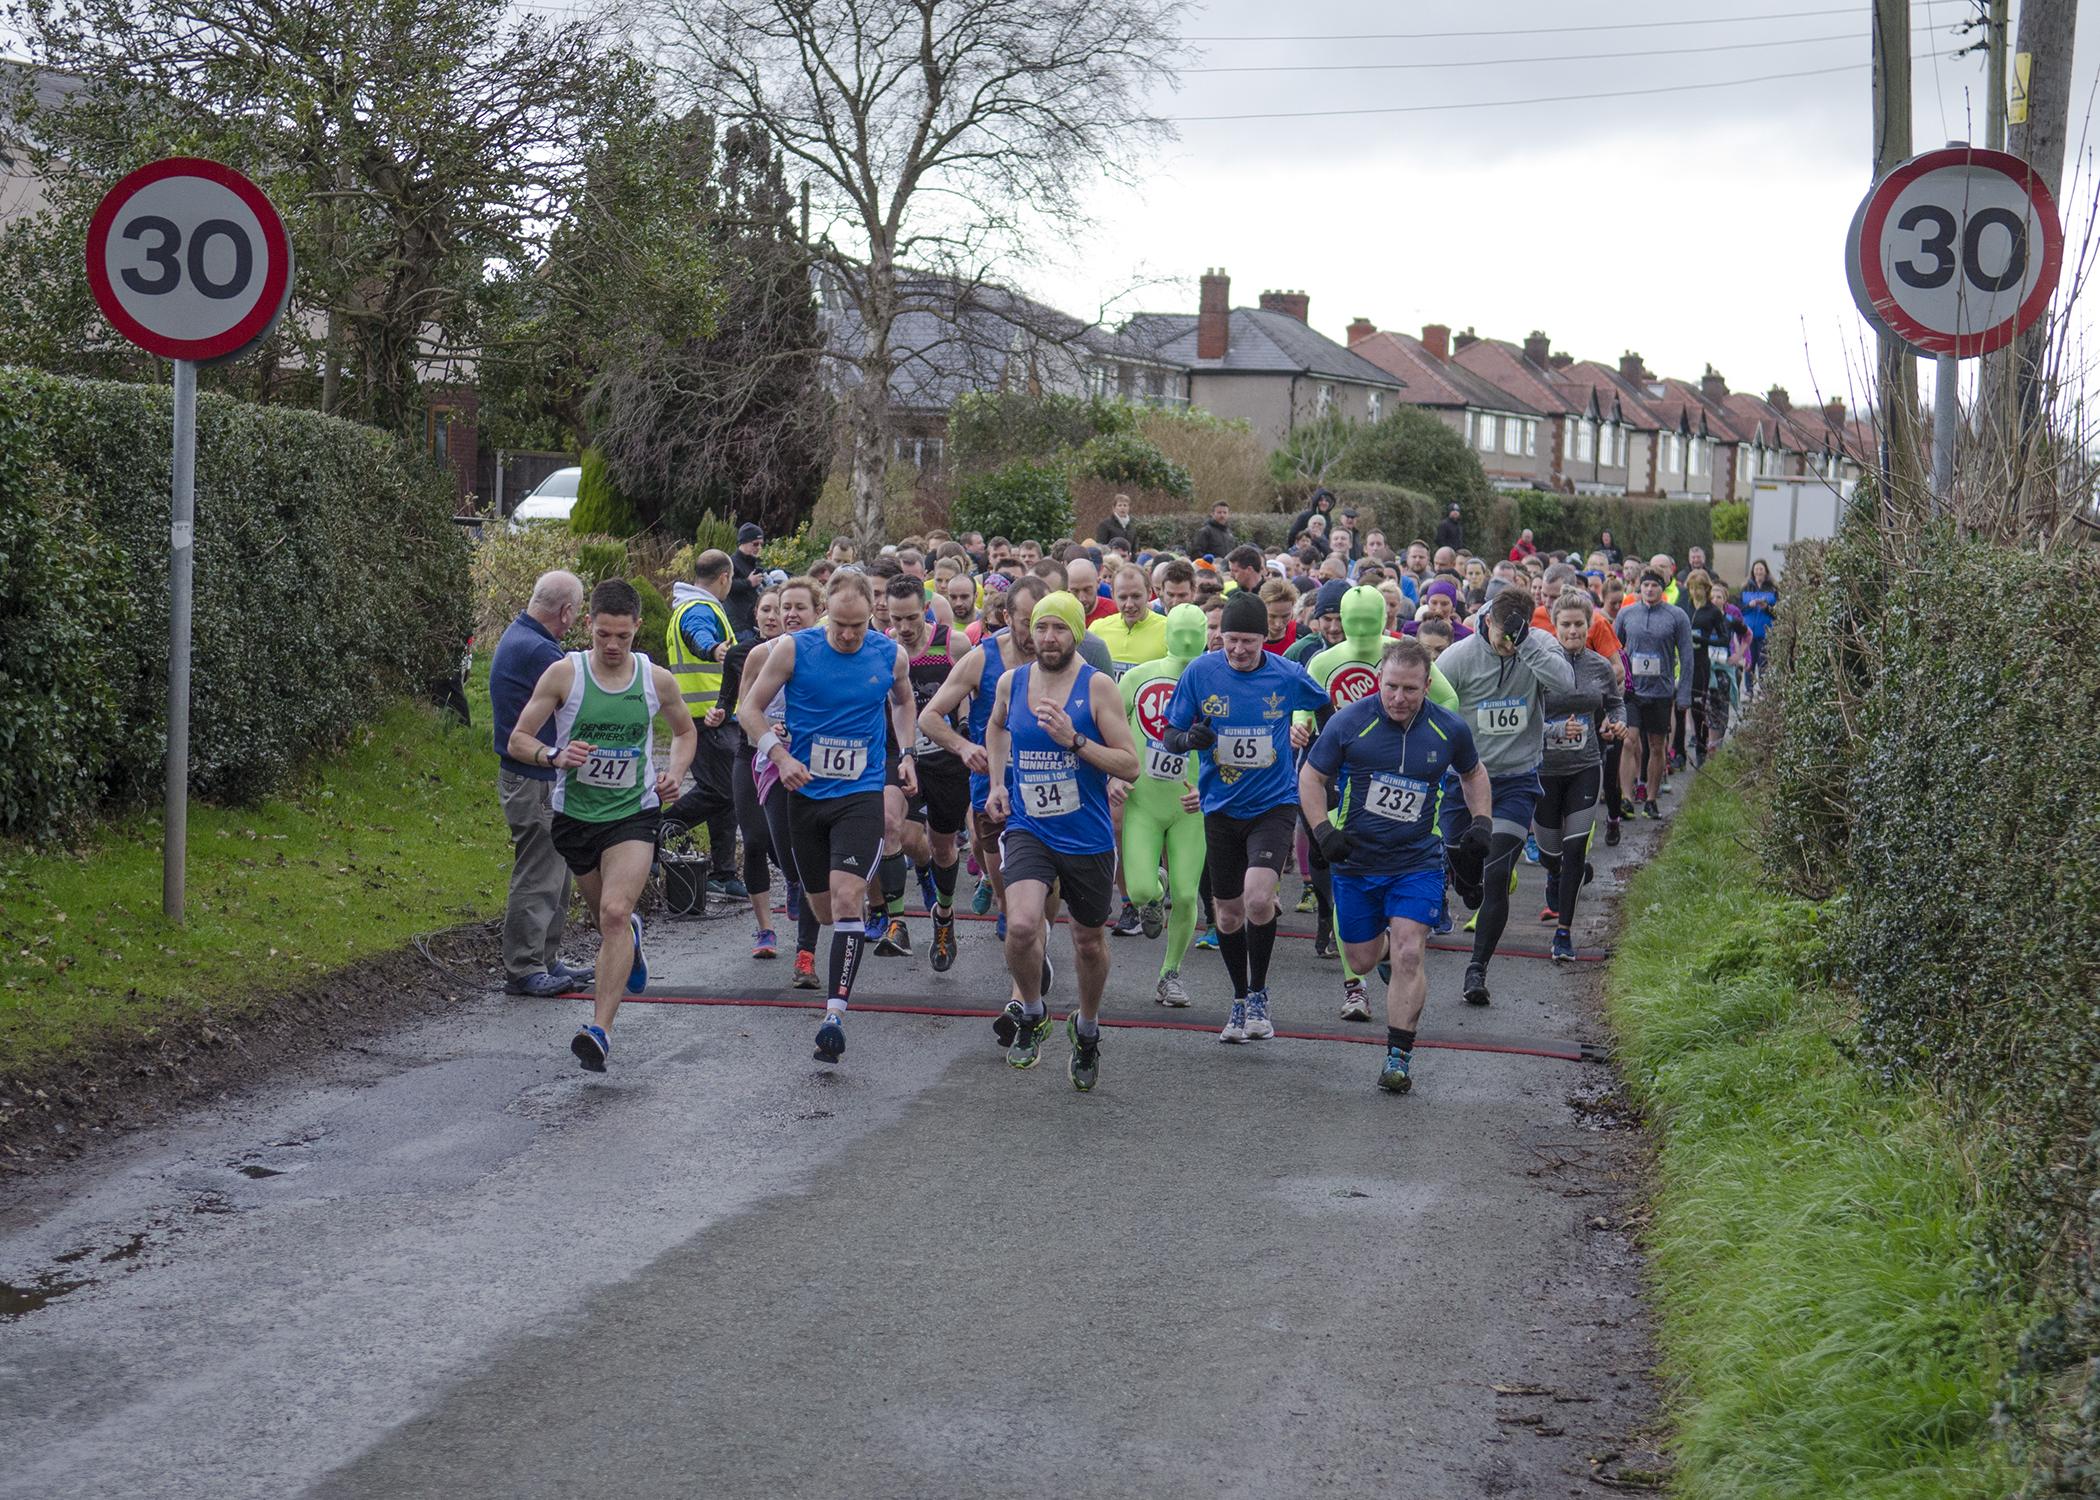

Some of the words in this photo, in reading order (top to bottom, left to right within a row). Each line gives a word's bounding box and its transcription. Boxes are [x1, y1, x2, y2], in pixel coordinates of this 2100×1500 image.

[1895, 205, 2026, 292] 30
[121, 215, 253, 300] 30
[1643, 659, 1650, 670] 9
[1483, 700, 1507, 708] RUTHIN
[1489, 708, 1519, 728] 166
[580, 723, 625, 732] DENBIGH
[579, 732, 625, 741] HARRIERS
[819, 737, 847, 747] RUTHIN
[850, 739, 863, 748] 10K
[591, 749, 617, 757] UTHIN
[1019, 750, 1060, 761] BUCKLEY
[1233, 738, 1257, 759] 65
[823, 748, 857, 771] 161
[1019, 760, 1063, 770] RUNNERS
[1152, 751, 1183, 775] 168
[588, 758, 630, 780] 247
[1024, 773, 1050, 782] RUTHIN
[1052, 771, 1068, 780] 10K
[1380, 774, 1407, 787] RUTHIN
[1408, 781, 1422, 790] 10K
[1035, 784, 1062, 808] 34
[1376, 786, 1416, 814] 232
